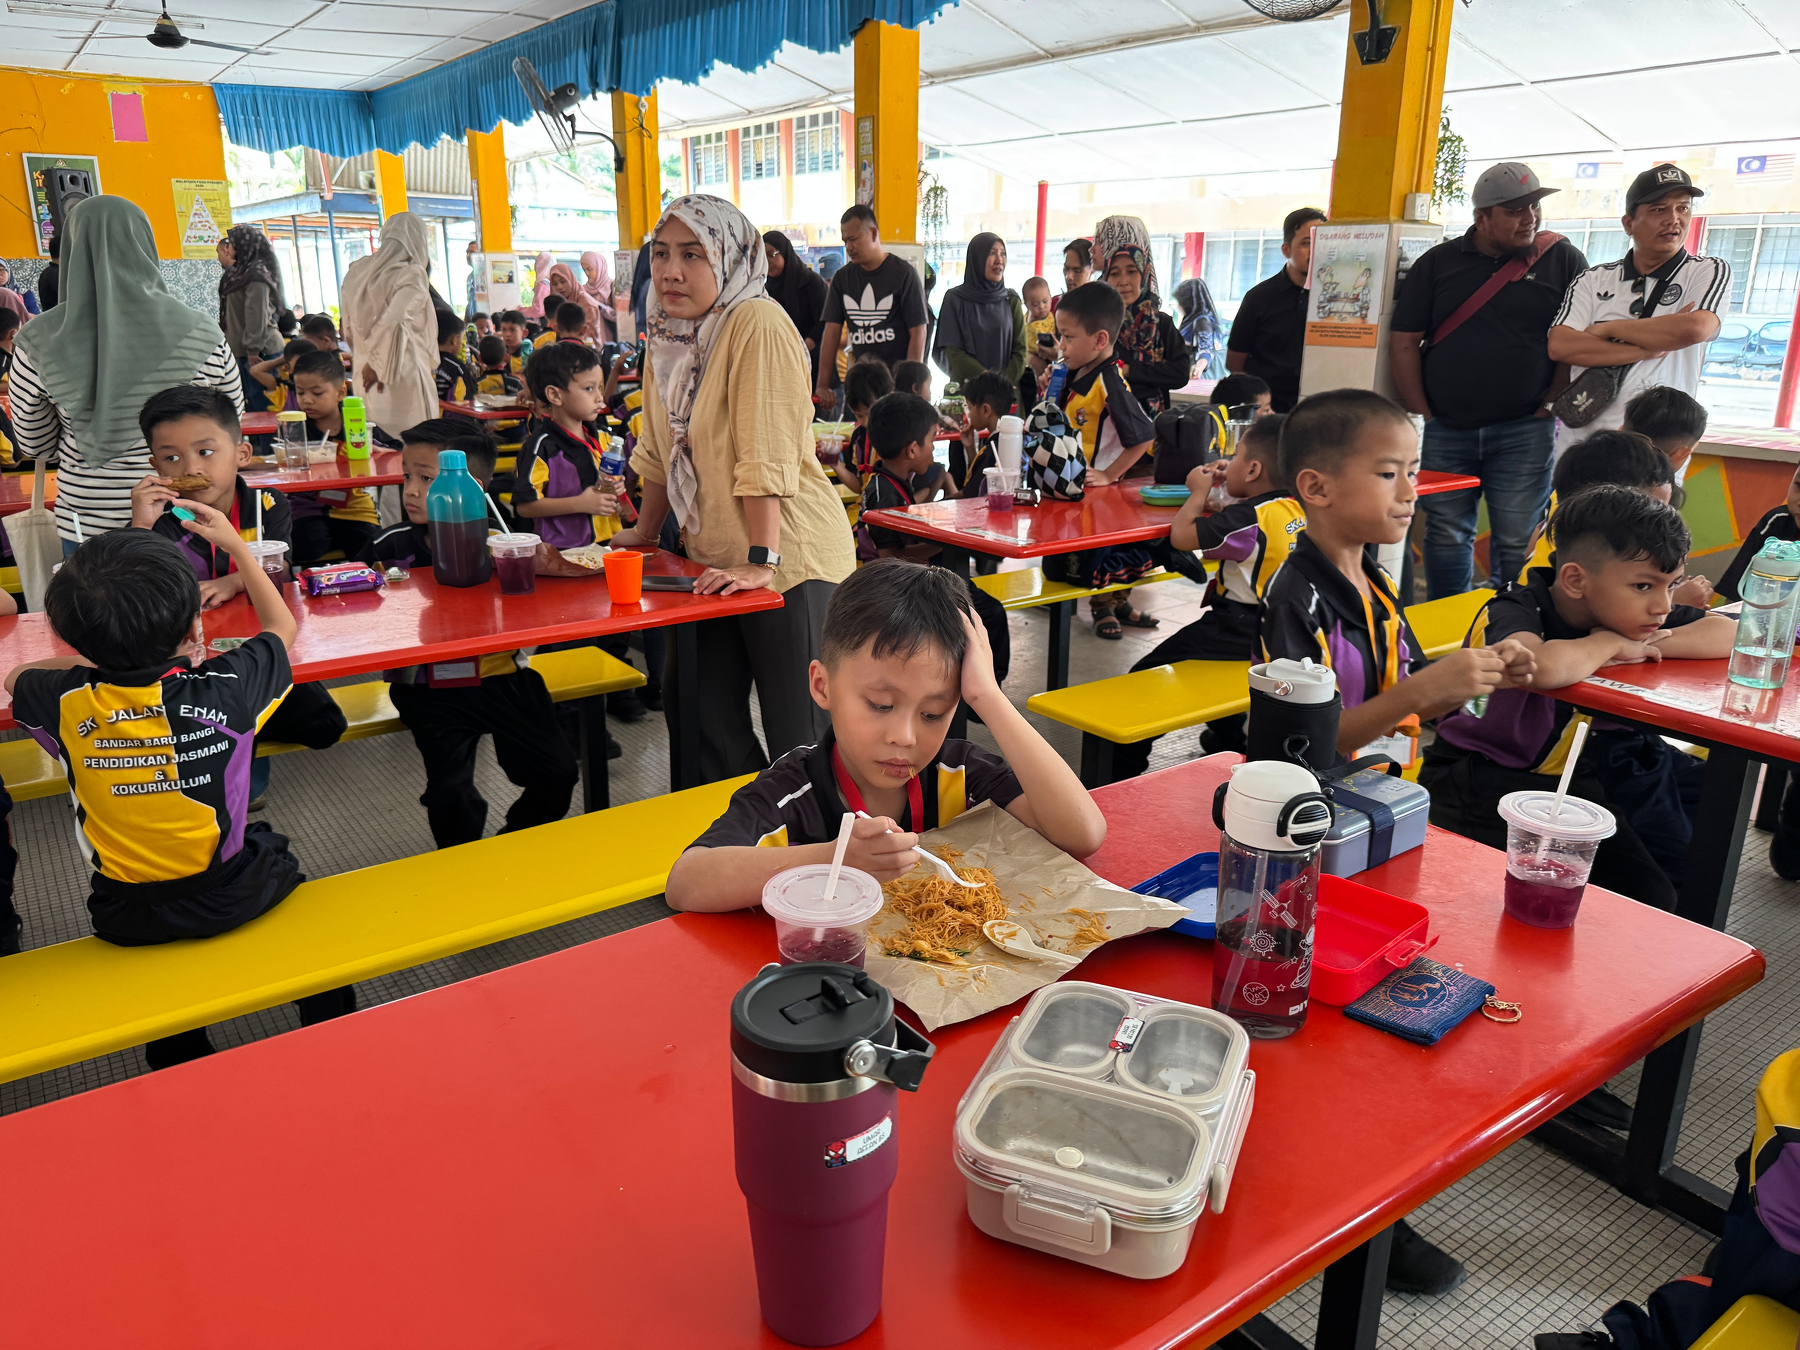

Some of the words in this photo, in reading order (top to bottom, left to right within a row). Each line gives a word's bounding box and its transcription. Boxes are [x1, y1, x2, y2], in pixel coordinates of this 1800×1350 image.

[1285, 518, 1299, 534] SK
[77, 716, 98, 737] SK
[105, 705, 166, 723] JALAN
[180, 704, 228, 726] ENAM
[94, 739, 142, 748] BANDAR
[144, 735, 177, 747] BARU
[180, 726, 215, 743] BANGI
[83, 755, 167, 768] PENDIDIKAN
[171, 739, 229, 764] JASMANI
[110, 773, 212, 795] KOKURIKULUM
[154, 770, 165, 781] &
